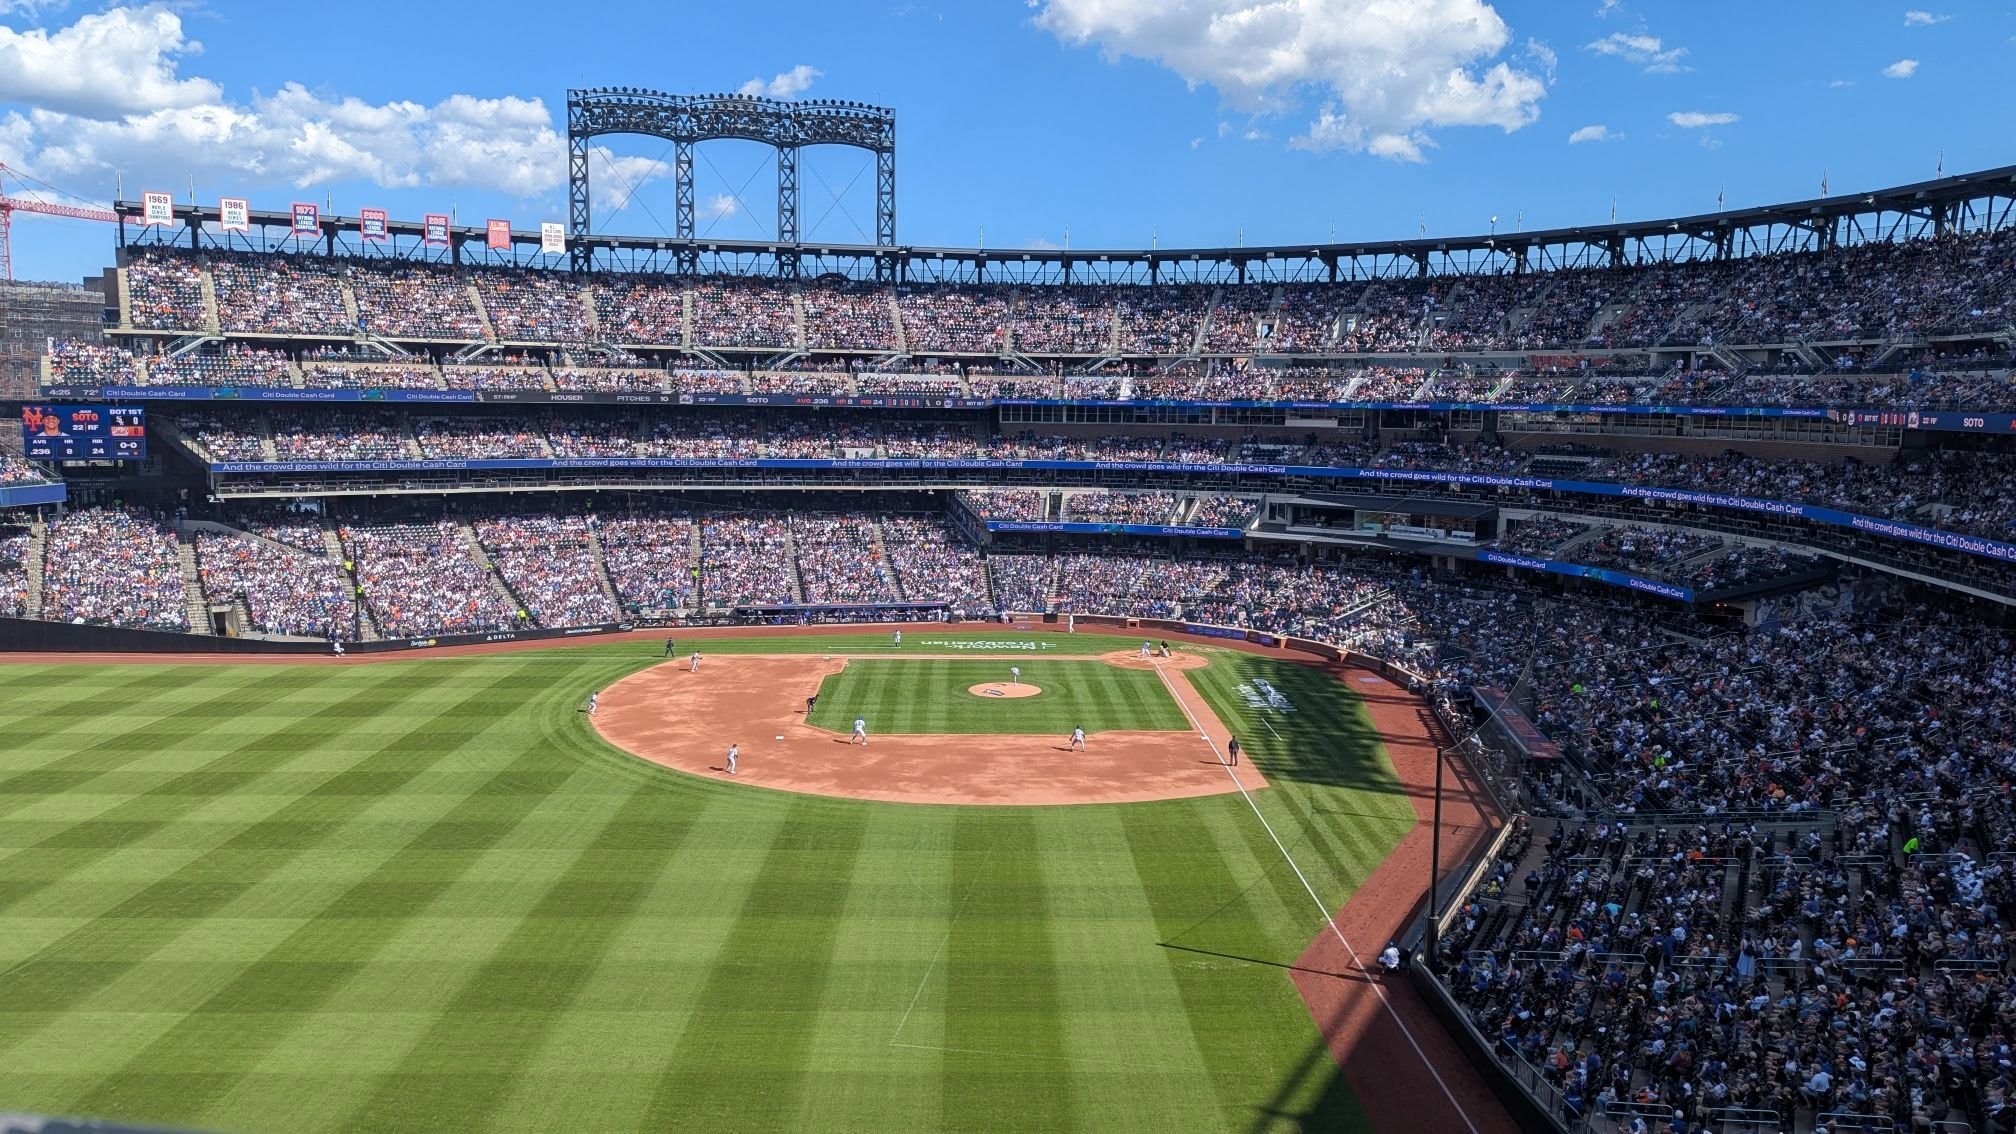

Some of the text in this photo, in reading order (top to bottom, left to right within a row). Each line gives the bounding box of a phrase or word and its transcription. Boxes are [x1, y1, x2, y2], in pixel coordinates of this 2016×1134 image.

[149, 196, 168, 204] 1969
[225, 201, 243, 209] 1986
[133, 417, 138, 425] 0
[1963, 417, 1984, 427] SOTO
[264, 462, 294, 470] crowd
[372, 461, 388, 469] Citi
[390, 461, 421, 469] Double
[1359, 470, 1375, 478] And
[1390, 471, 1413, 480] crowd
[1447, 474, 1457, 482] for
[1458, 475, 1471, 483] the
[1472, 476, 1485, 484] Citi
[1486, 477, 1513, 485] Double
[1514, 478, 1534, 486] Cash
[1535, 479, 1552, 487] Card
[1622, 487, 1802, 513] And the crowd goes wild for the Citi Double Cash Card
[1852, 517, 2006, 556] And the crowd goes wild for the Citi Double Cash
[1498, 555, 1516, 563] Double
[1639, 582, 1656, 591] Double
[1657, 585, 1670, 594] Cash
[1671, 589, 1683, 598] Card
